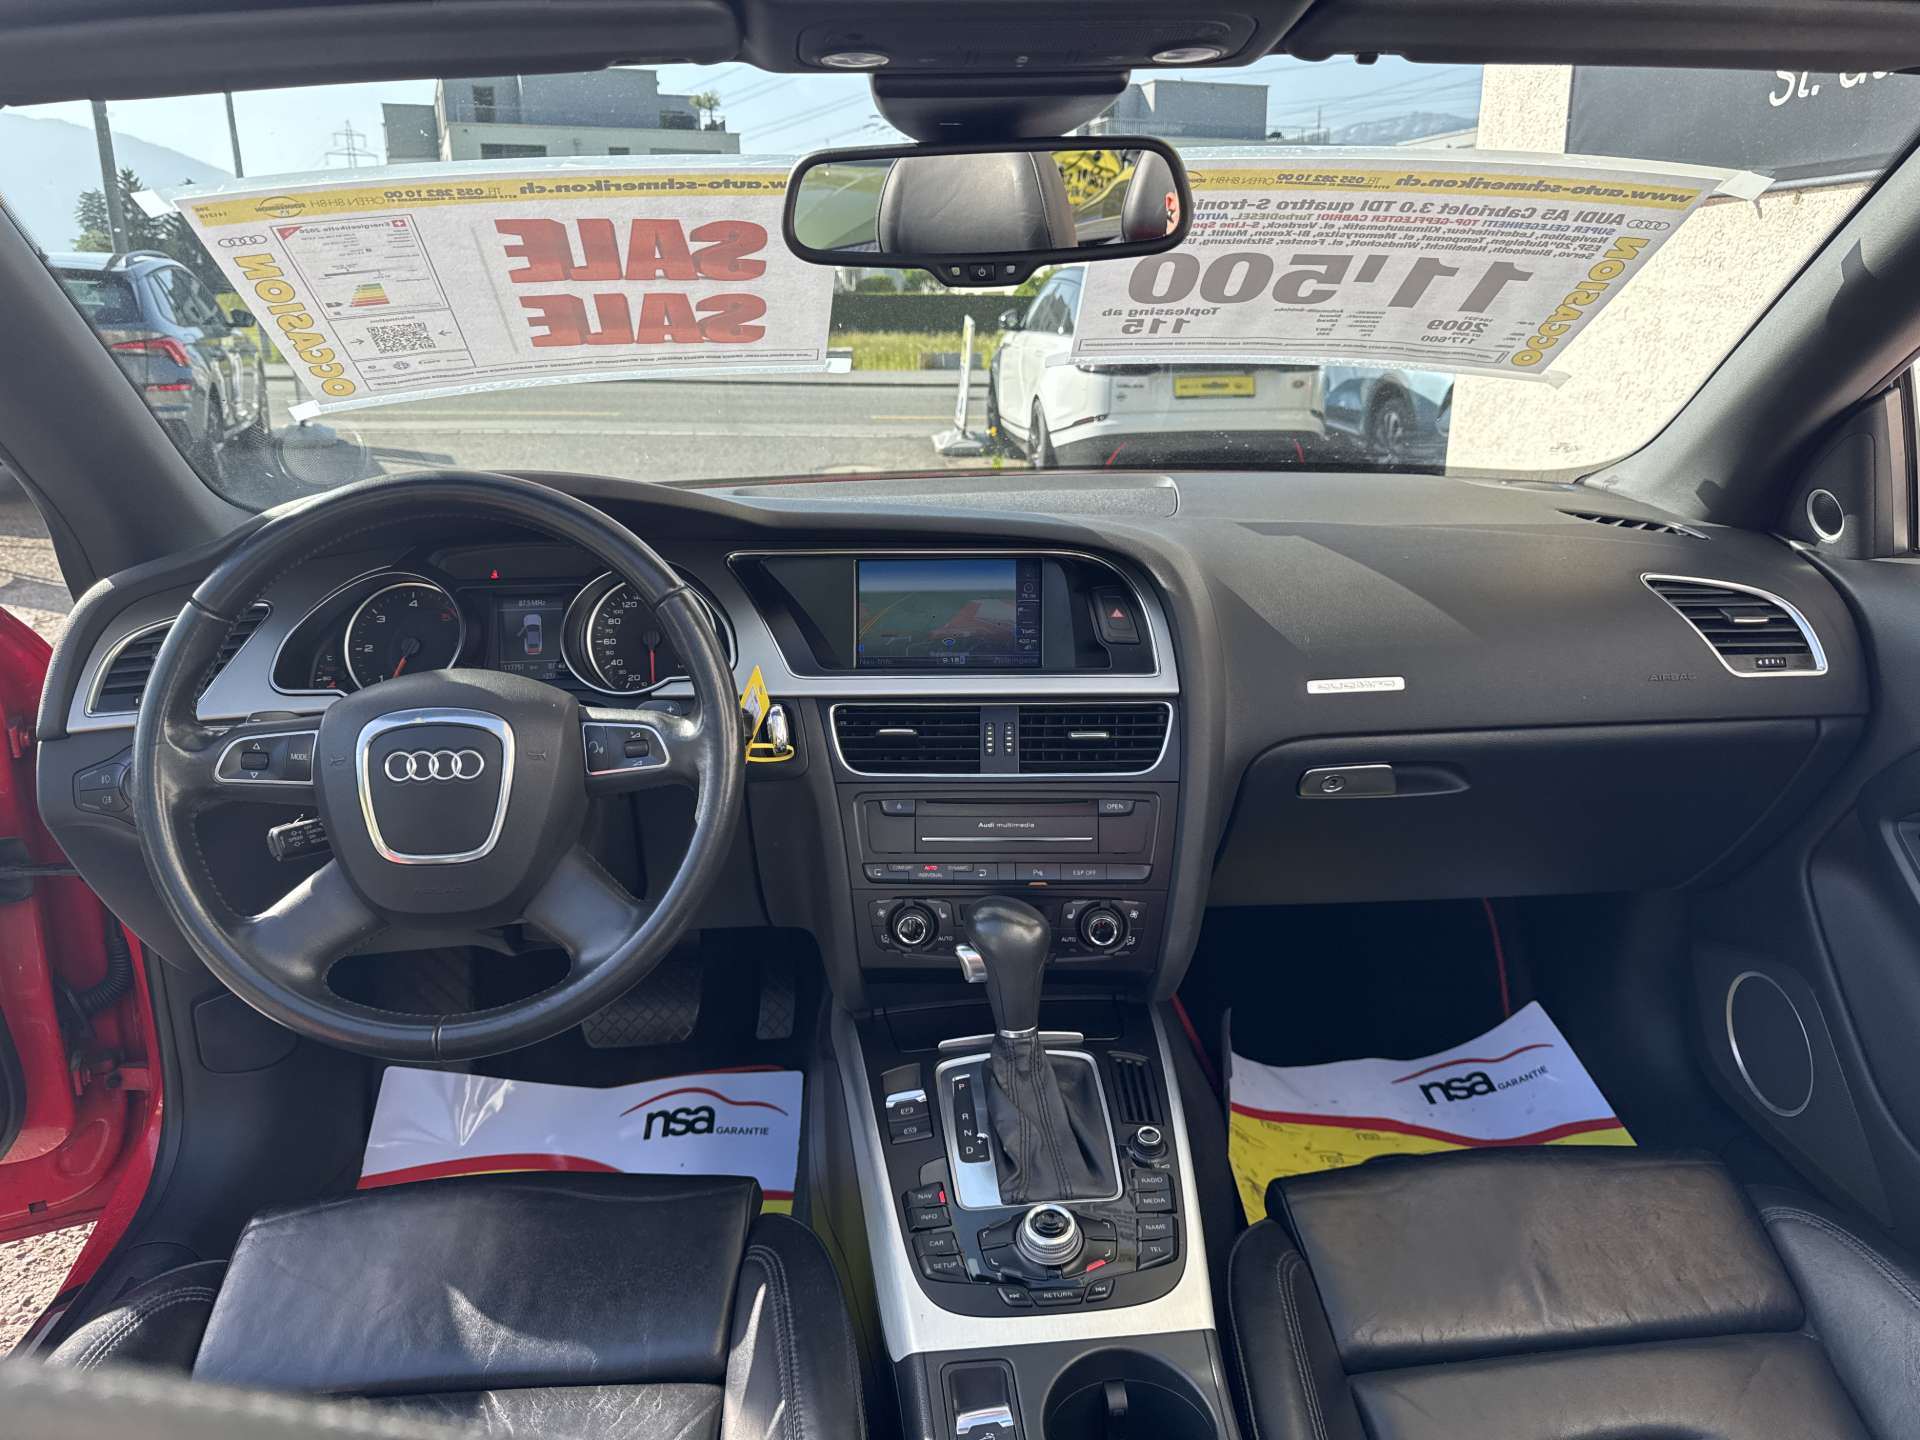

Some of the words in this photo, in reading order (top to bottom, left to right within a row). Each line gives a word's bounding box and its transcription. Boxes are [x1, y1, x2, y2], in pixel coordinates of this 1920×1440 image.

[409, 600, 418, 608] 4
[622, 601, 638, 609] 120
[1419, 1070, 1497, 1105] nsa
[1498, 1065, 1548, 1091] GARANTIE
[643, 1105, 715, 1140] nsa
[716, 1126, 769, 1137] GARANTIE
[933, 1262, 958, 1270] SETUP
